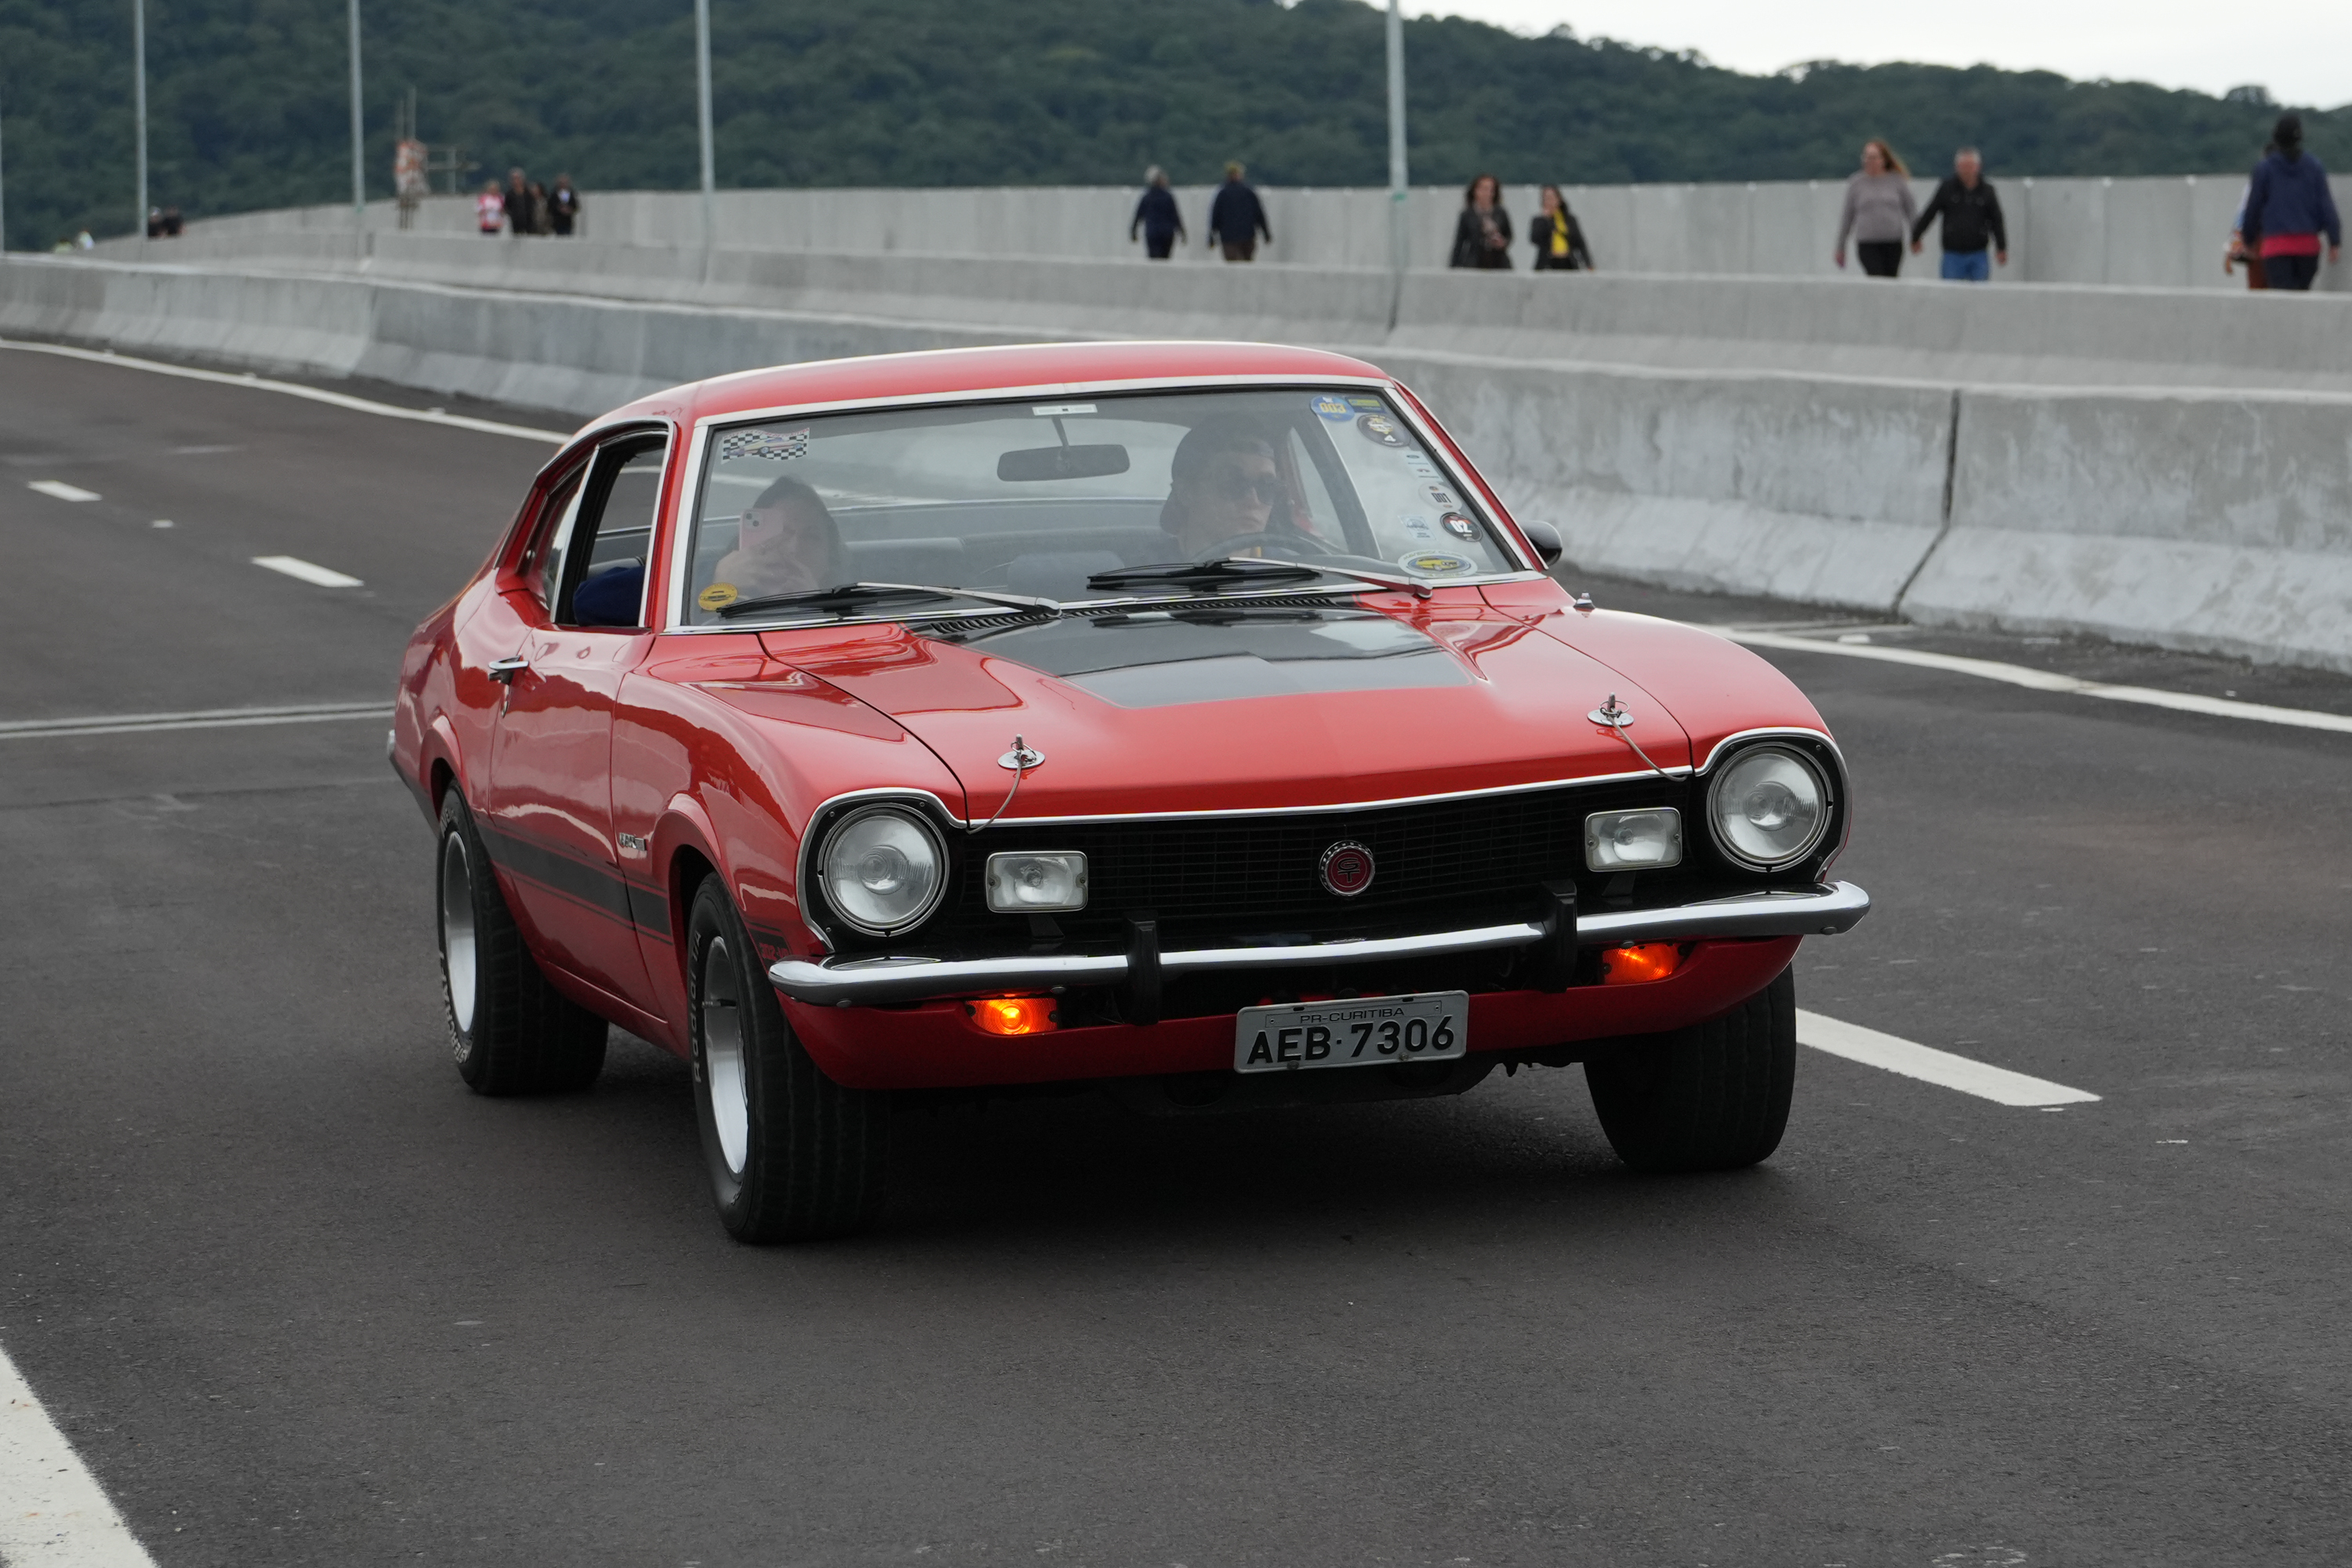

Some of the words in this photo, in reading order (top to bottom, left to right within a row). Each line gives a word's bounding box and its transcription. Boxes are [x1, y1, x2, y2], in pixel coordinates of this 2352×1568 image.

[1319, 402, 1347, 413] 003
[1449, 520, 1472, 533] 02
[1300, 1007, 1405, 1024] PR-CURITIBA
